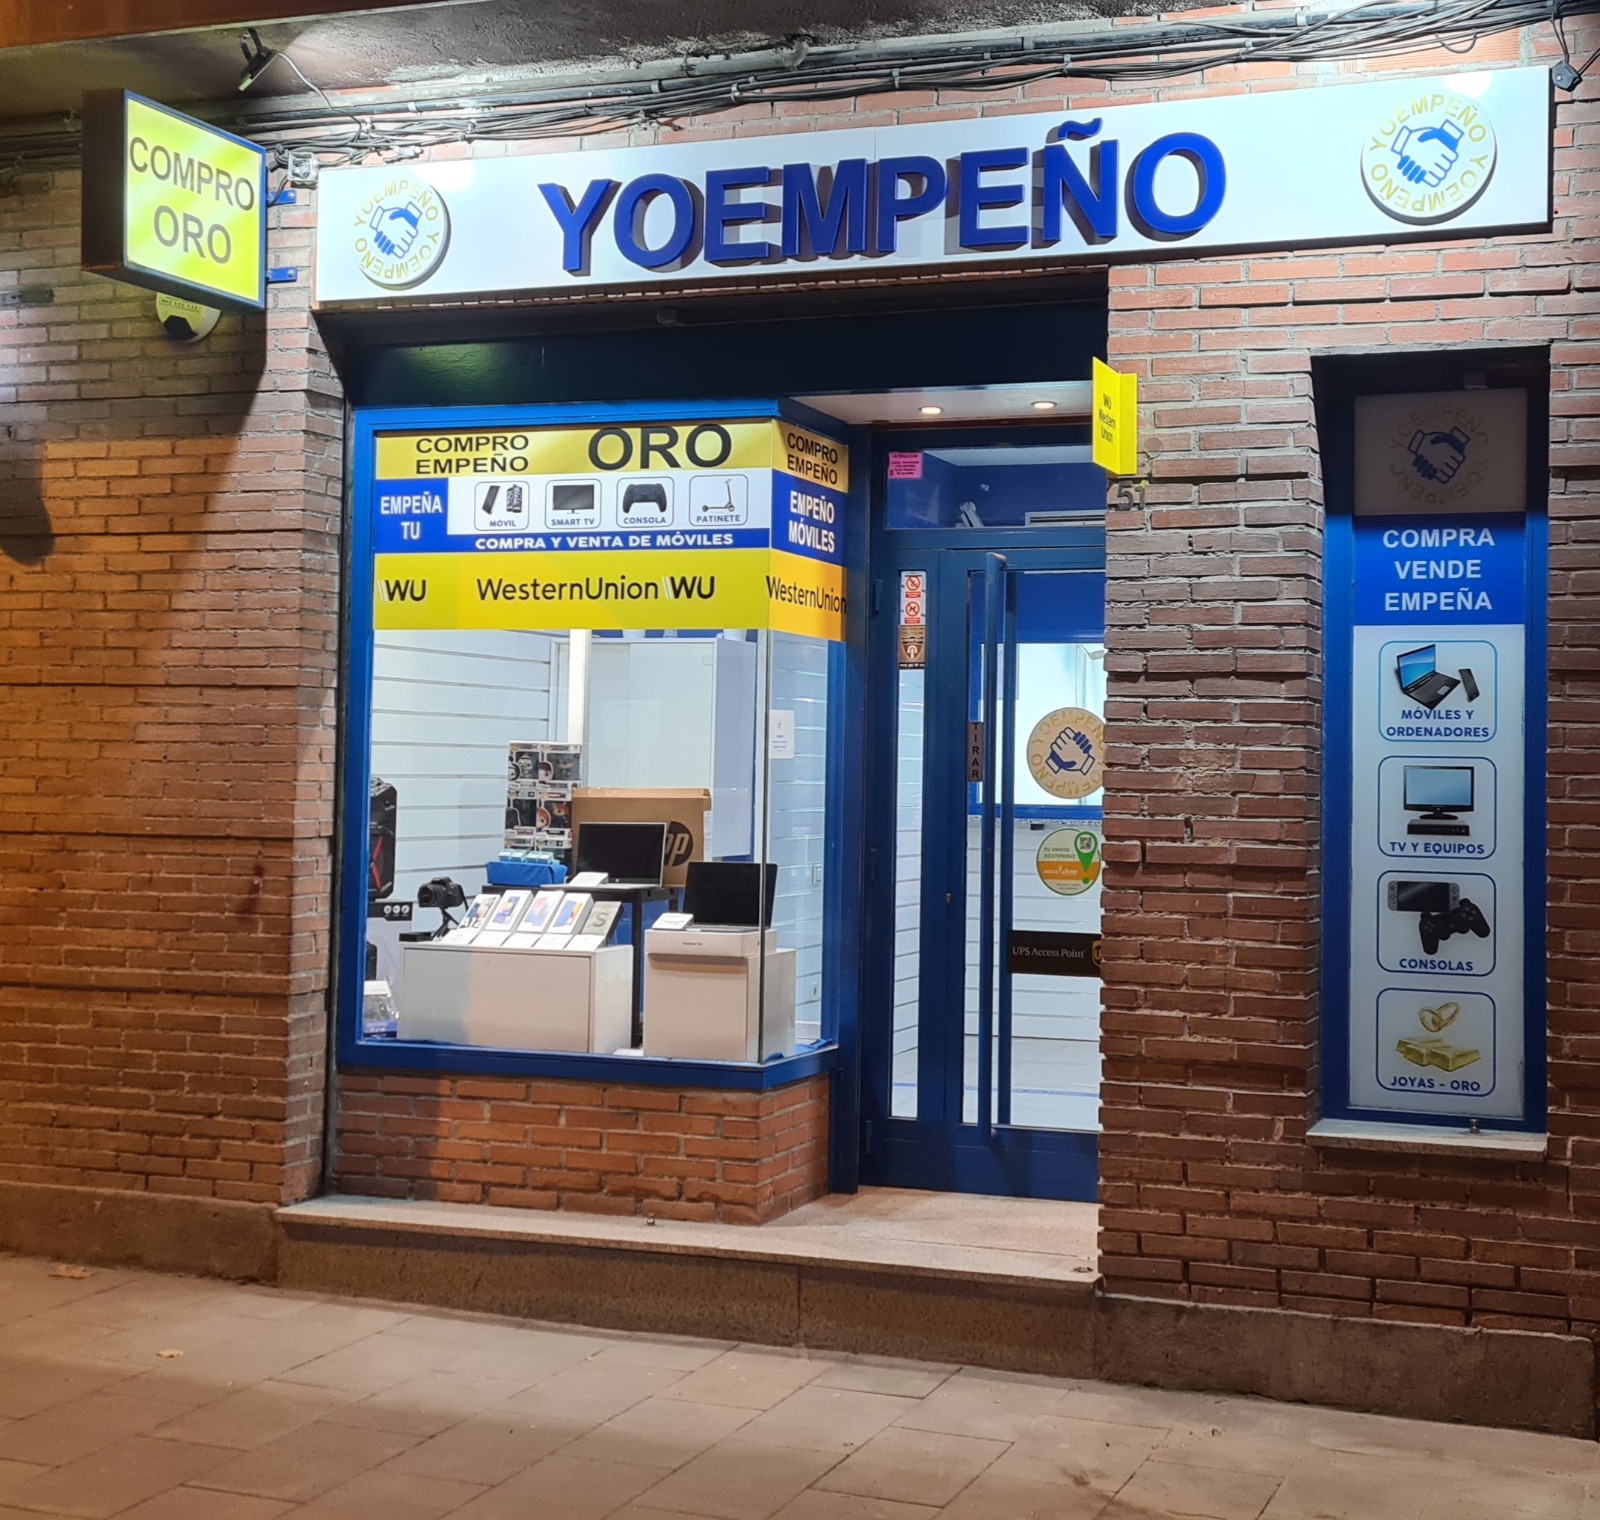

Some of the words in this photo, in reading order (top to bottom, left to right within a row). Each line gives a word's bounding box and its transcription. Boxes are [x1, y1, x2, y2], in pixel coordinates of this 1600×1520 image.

[129, 136, 255, 212] COMPRO
[537, 118, 1226, 273] YOEMPEÑO
[153, 205, 232, 265] ORO
[415, 433, 530, 454] COMPRO
[588, 424, 732, 471] ORO
[786, 431, 838, 465] COMPRO
[415, 454, 529, 474] EMPEÑO
[786, 452, 838, 485] EMPEÑO
[380, 495, 442, 515] EMPEÑA
[1117, 480, 1146, 511] 51
[788, 489, 834, 525] EMPEÑO
[551, 518, 582, 526] SMART
[584, 517, 596, 525] TV
[623, 516, 667, 525] CONSOLA
[696, 514, 741, 523] PATINETE
[401, 521, 421, 540] TU
[475, 536, 547, 550] COMPRA
[550, 537, 563, 549] Y
[566, 535, 621, 548] VENTA
[628, 534, 652, 547] DE
[655, 530, 735, 547] MÓVILES
[788, 519, 835, 553] MÓVILES
[1383, 528, 1495, 548] COMPRA
[1394, 560, 1481, 580] VENDE
[385, 579, 426, 601] WU
[477, 575, 659, 601] WesternUnion
[669, 575, 716, 600] WU
[1385, 588, 1493, 611] EMPEÑA
[1401, 706, 1463, 720] MÓVILES
[1466, 711, 1474, 719] Y
[1386, 727, 1490, 738] ORDENADORES
[971, 722, 980, 779] TIRAR
[1390, 842, 1406, 853] TV
[1410, 842, 1420, 853] Y
[1424, 843, 1485, 854] EQUIPOS
[1012, 947, 1030, 957] UPS
[1031, 947, 1059, 958] Access
[1060, 948, 1084, 959] Point
[1400, 959, 1474, 972] CONSOLAS
[1391, 1076, 1435, 1089] JOYAS
[1451, 1078, 1481, 1091] ORO
